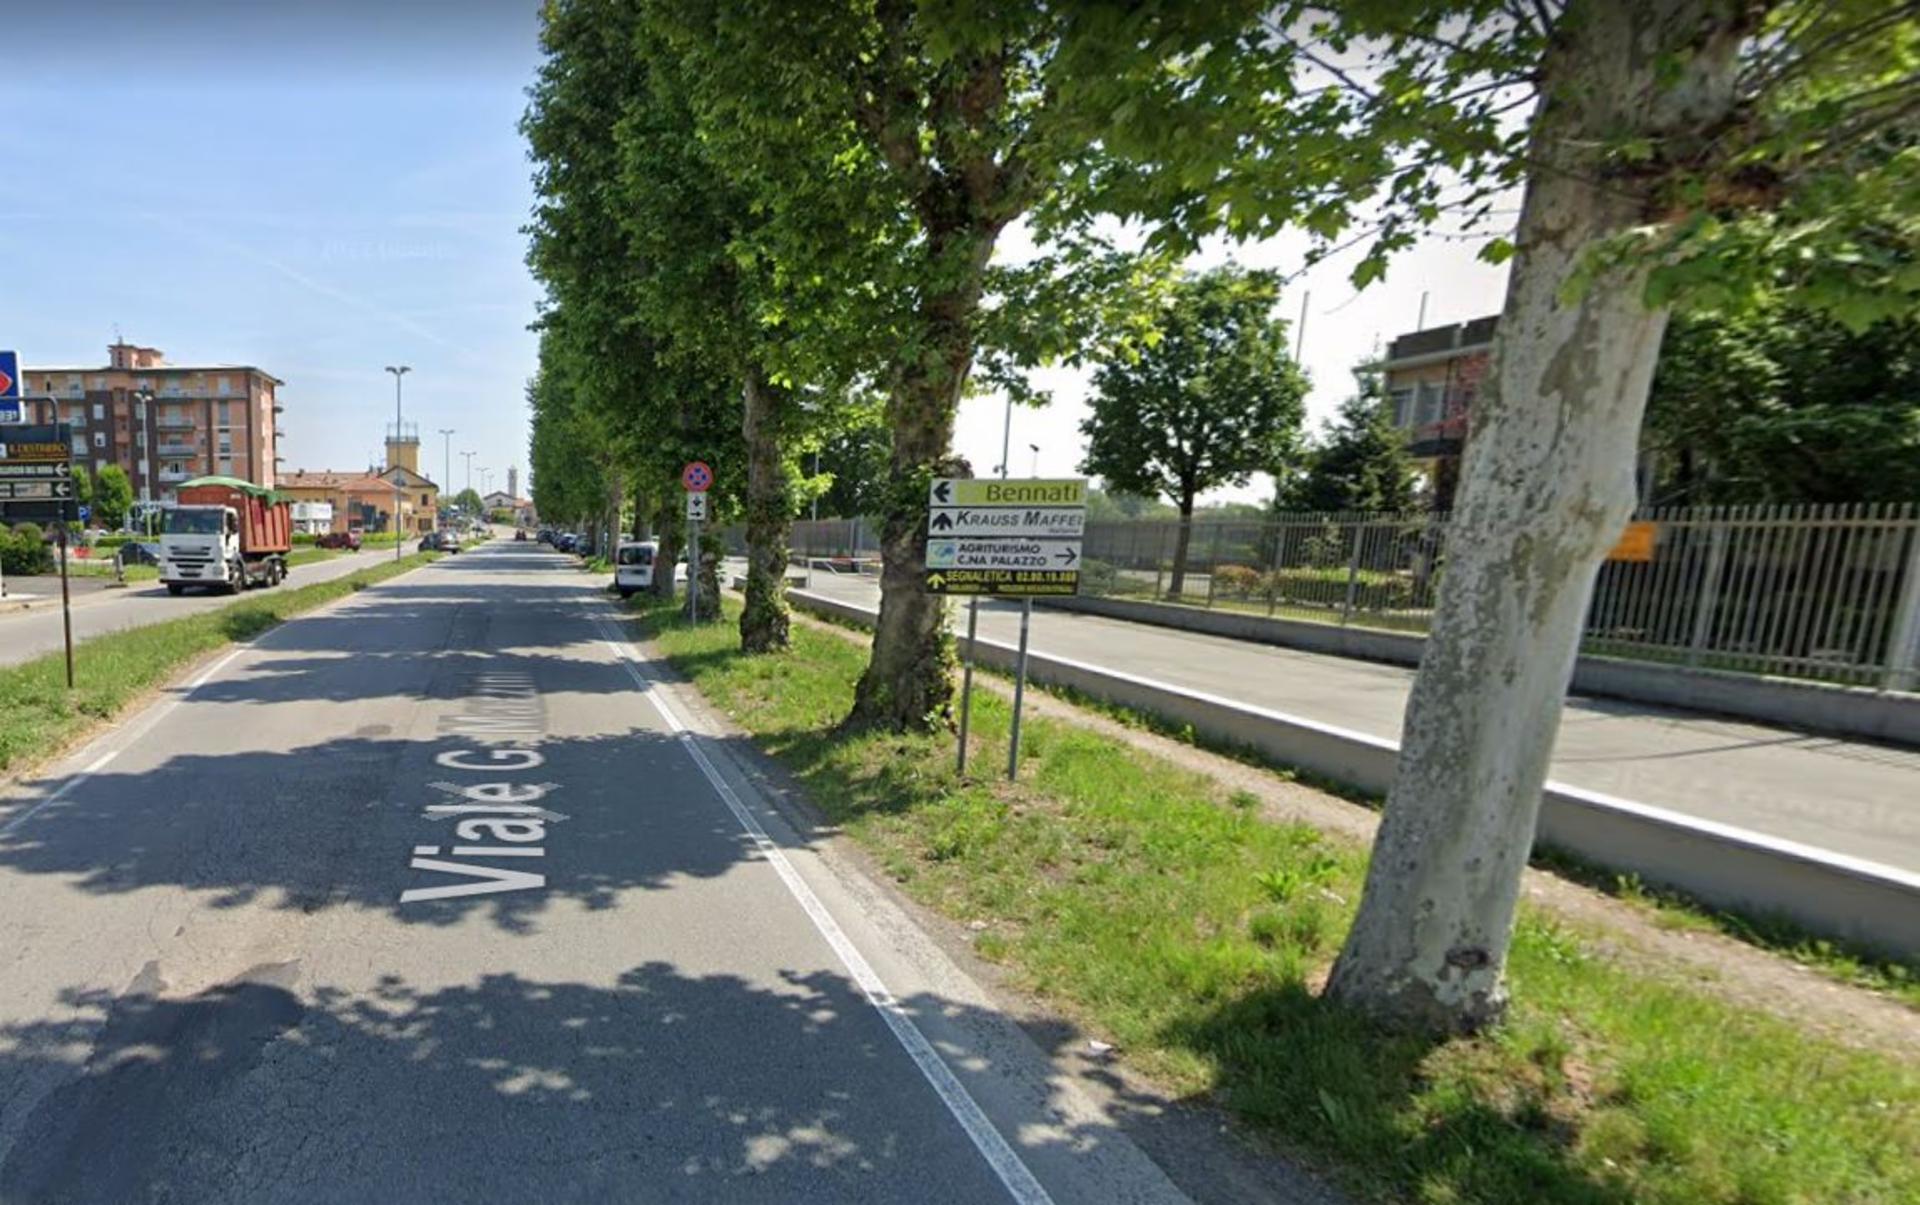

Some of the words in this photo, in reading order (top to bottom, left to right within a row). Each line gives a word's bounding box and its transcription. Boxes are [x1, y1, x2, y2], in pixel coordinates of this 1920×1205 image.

[986, 483, 1078, 502] Bennati
[956, 511, 1019, 526] KRAUSS
[958, 543, 1041, 554] AGRITURISMO
[957, 555, 987, 565] C.NA
[990, 556, 1047, 566] PALAZZO
